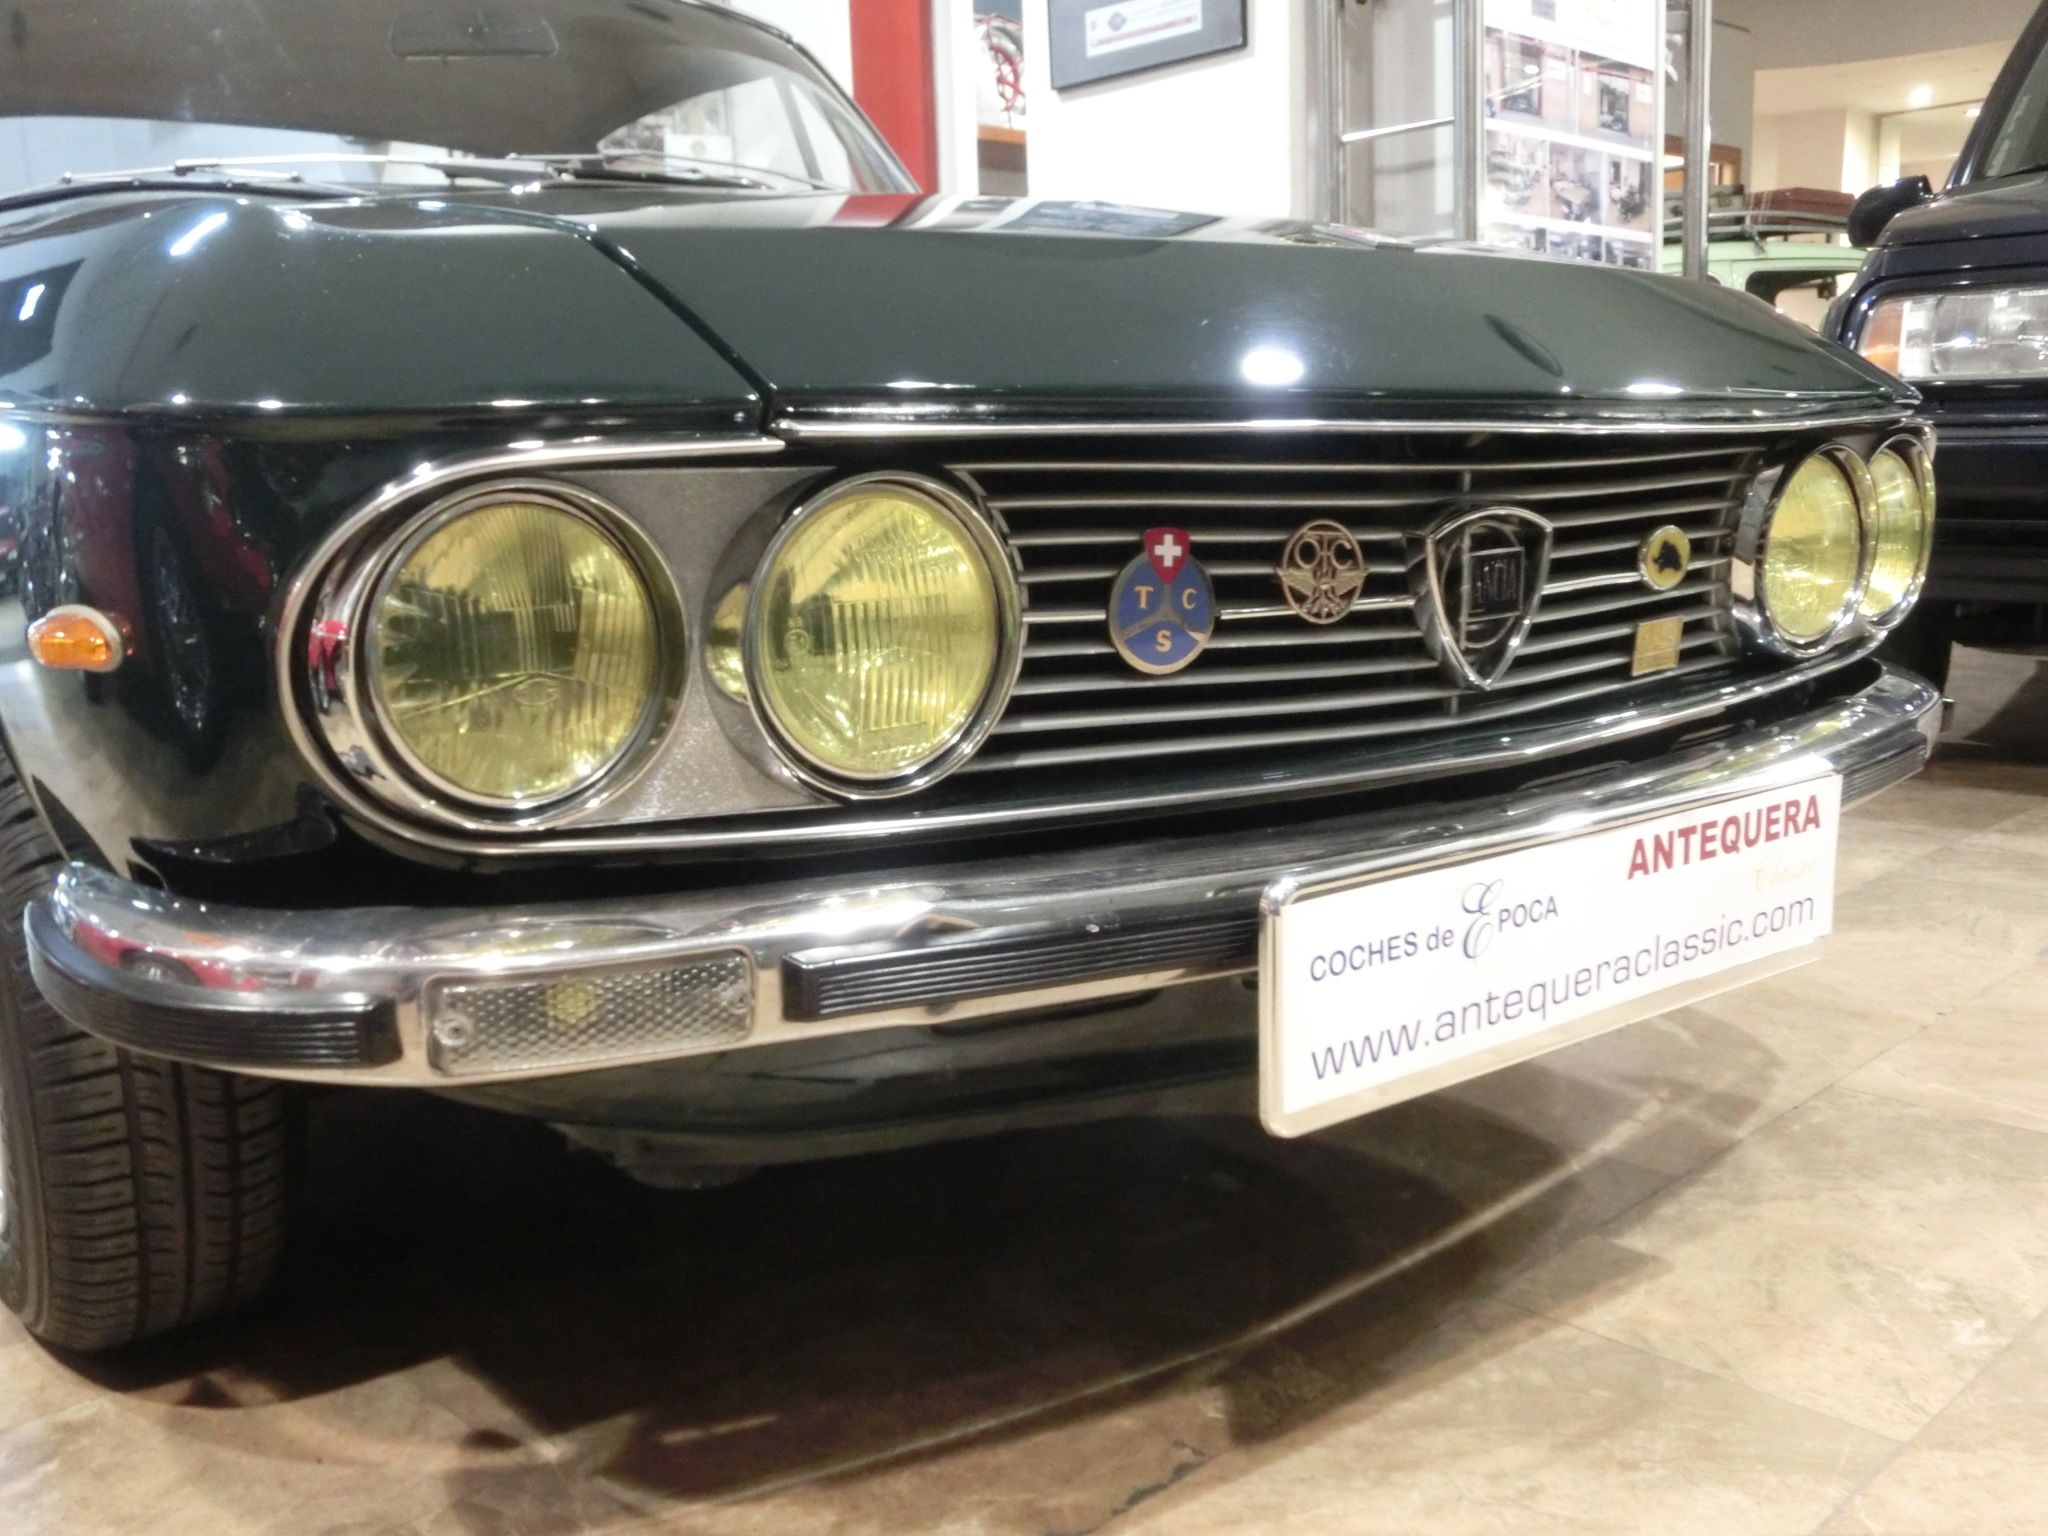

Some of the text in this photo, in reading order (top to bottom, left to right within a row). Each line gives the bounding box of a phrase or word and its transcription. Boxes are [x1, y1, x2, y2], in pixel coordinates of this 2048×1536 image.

[1627, 794, 1821, 880] ANTEQUERA
[1309, 931, 1418, 982] COCHES
[1426, 925, 1455, 953] de
[1310, 895, 1816, 1081] www.antequeraclassic.com
